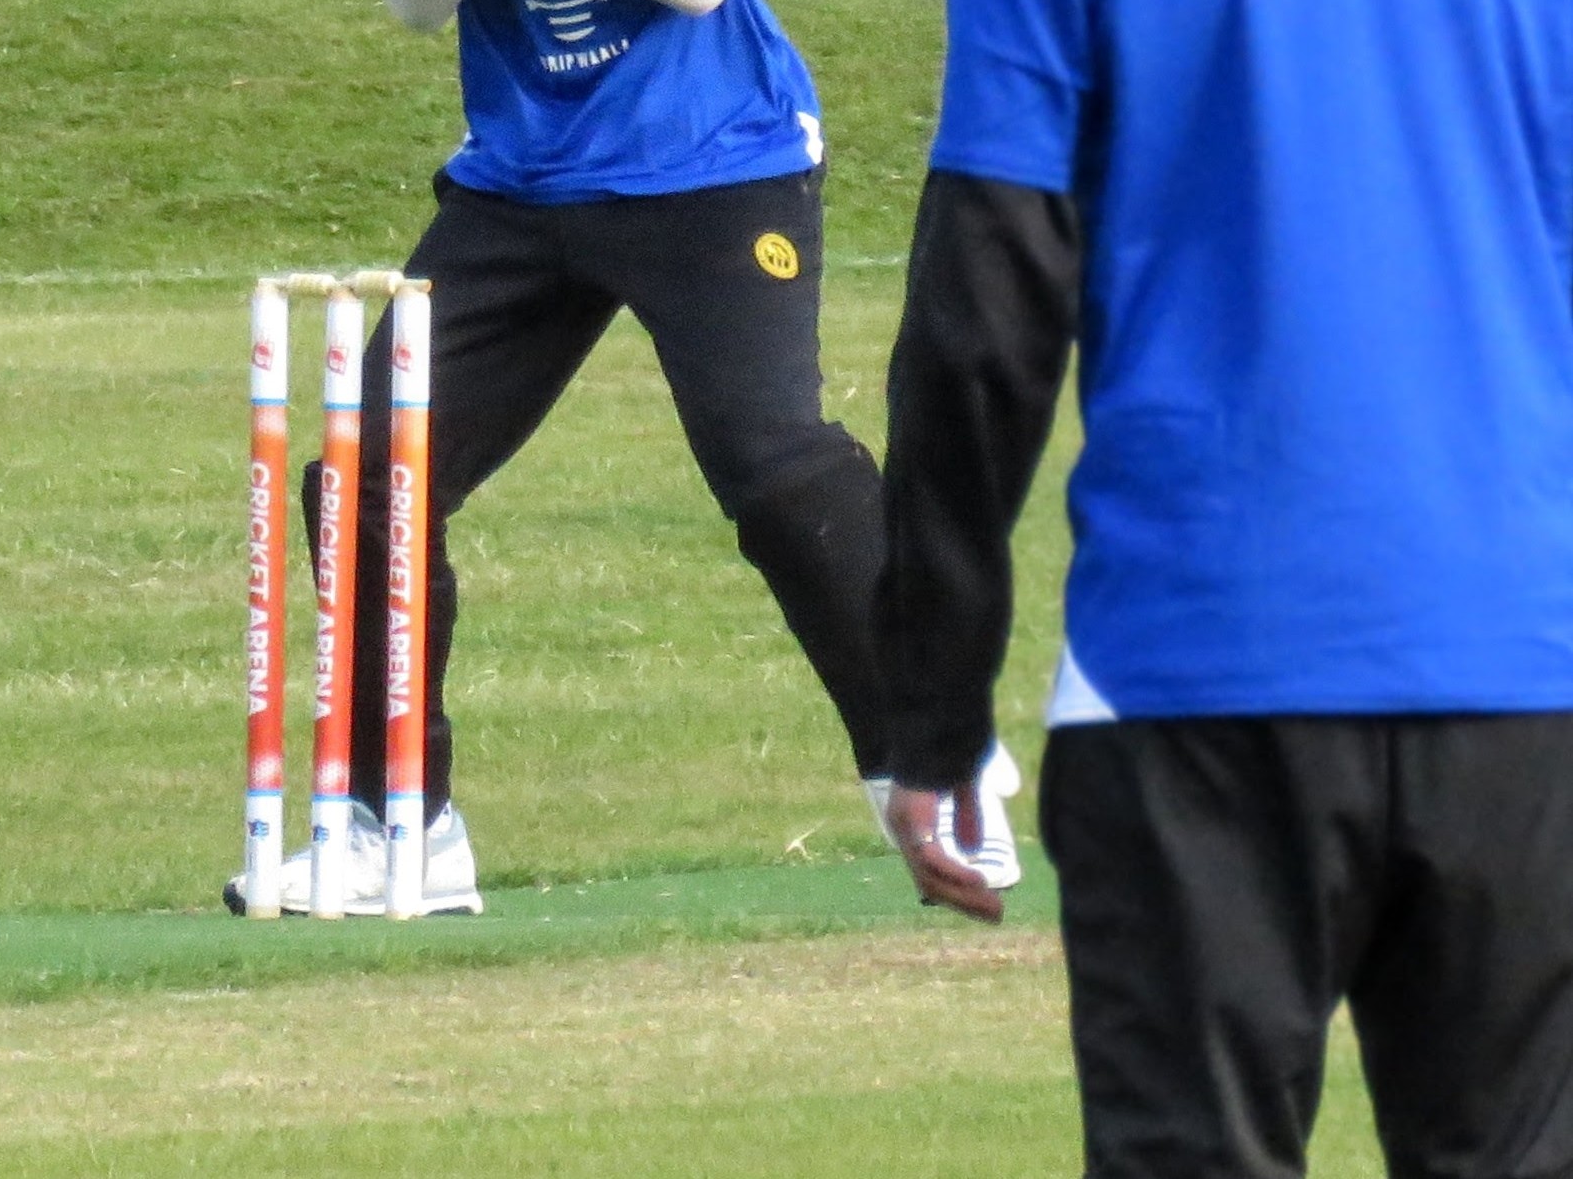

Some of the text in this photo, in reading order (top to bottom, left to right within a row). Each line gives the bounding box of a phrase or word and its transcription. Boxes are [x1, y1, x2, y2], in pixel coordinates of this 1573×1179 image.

[247, 461, 271, 717] CRICKET ARENA
[314, 465, 341, 720] CRICKET ARENA
[387, 462, 413, 721] CRICKET ARENA
